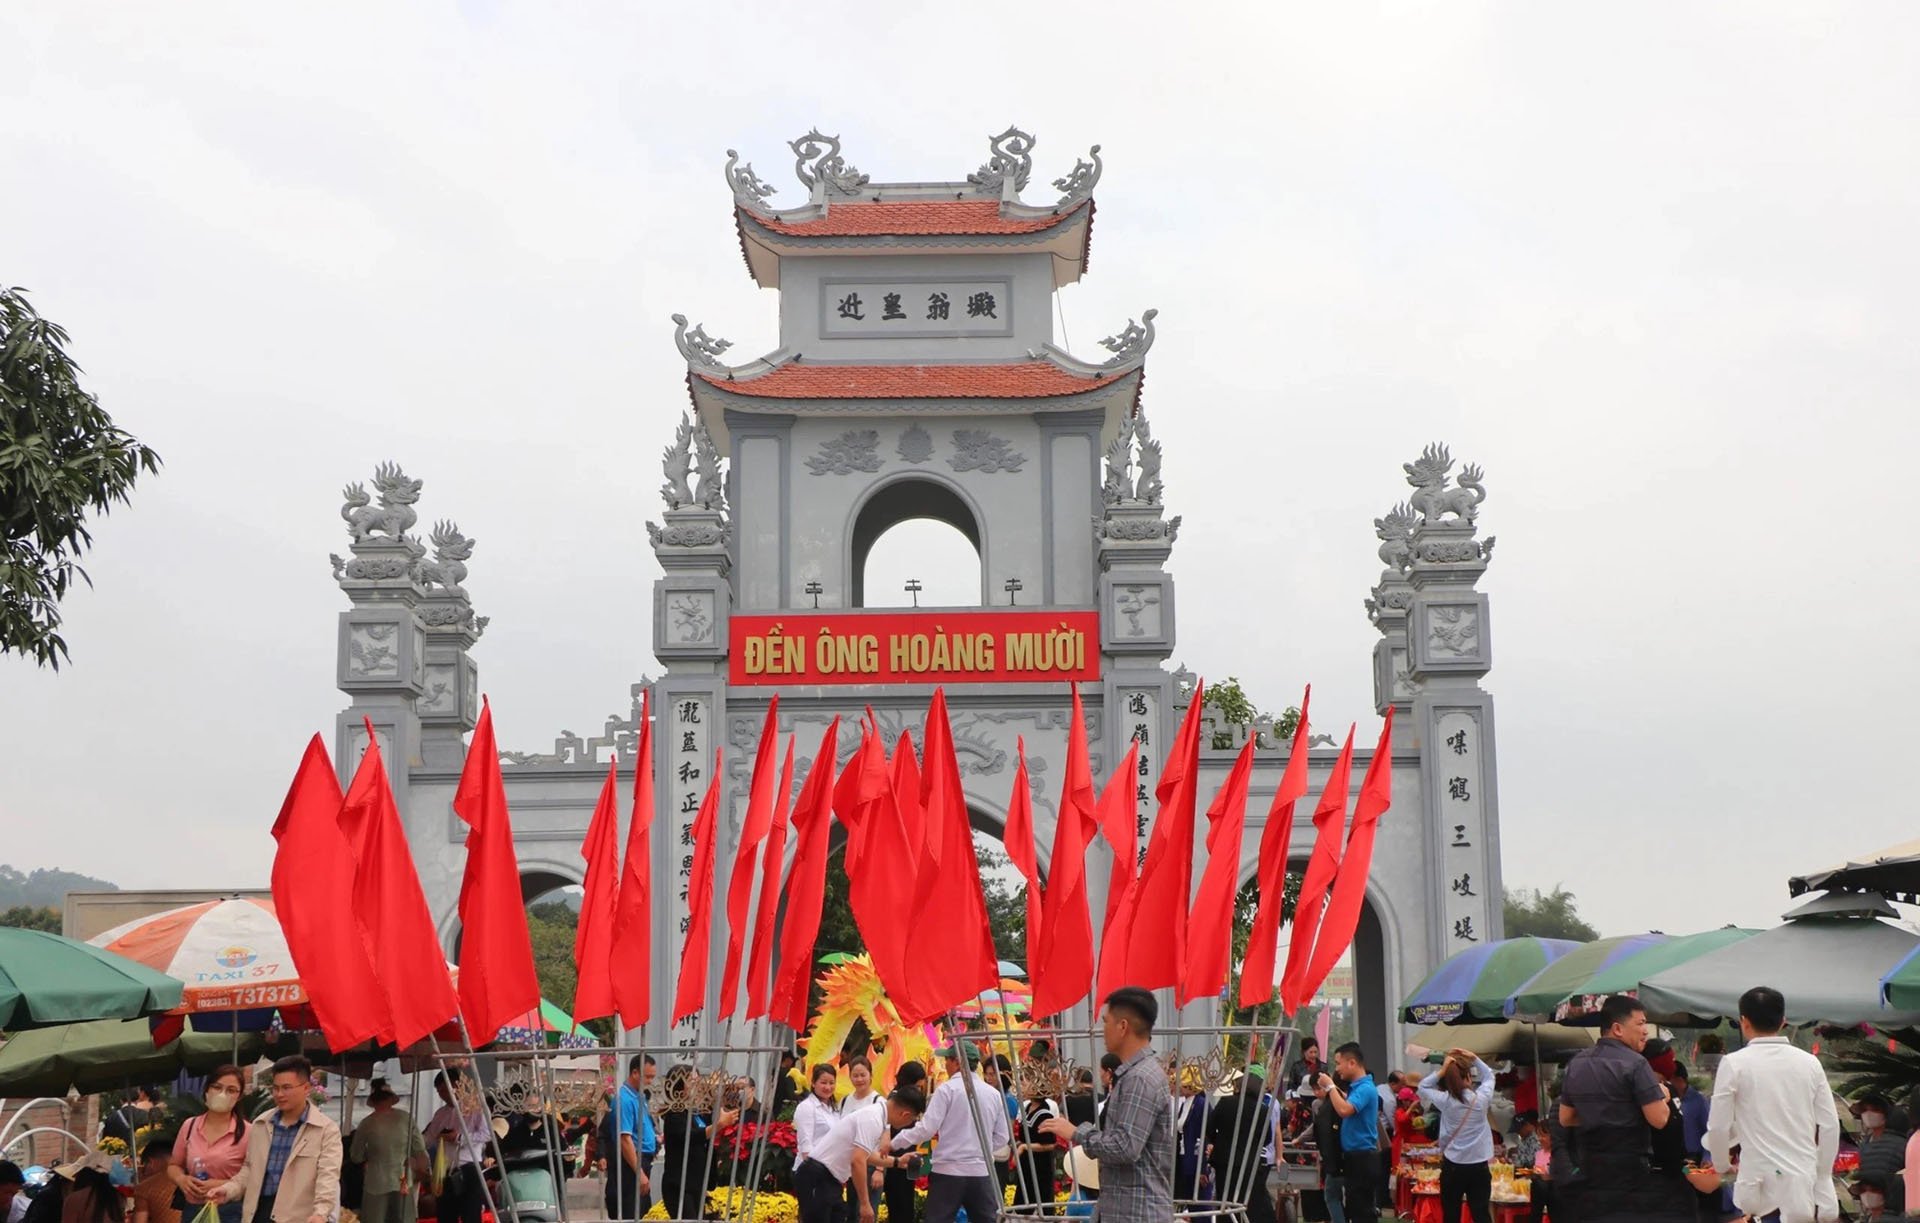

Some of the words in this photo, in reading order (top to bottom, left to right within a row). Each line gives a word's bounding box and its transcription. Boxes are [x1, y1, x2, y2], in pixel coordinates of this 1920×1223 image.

[745, 623, 805, 674] ĐỀN
[816, 627, 878, 674] ÔNG
[890, 625, 995, 673] HOÀNG
[1005, 622, 1085, 671] MƯỜI
[196, 970, 246, 981] TAXI
[252, 964, 279, 976] 37
[235, 984, 300, 1005] 737373
